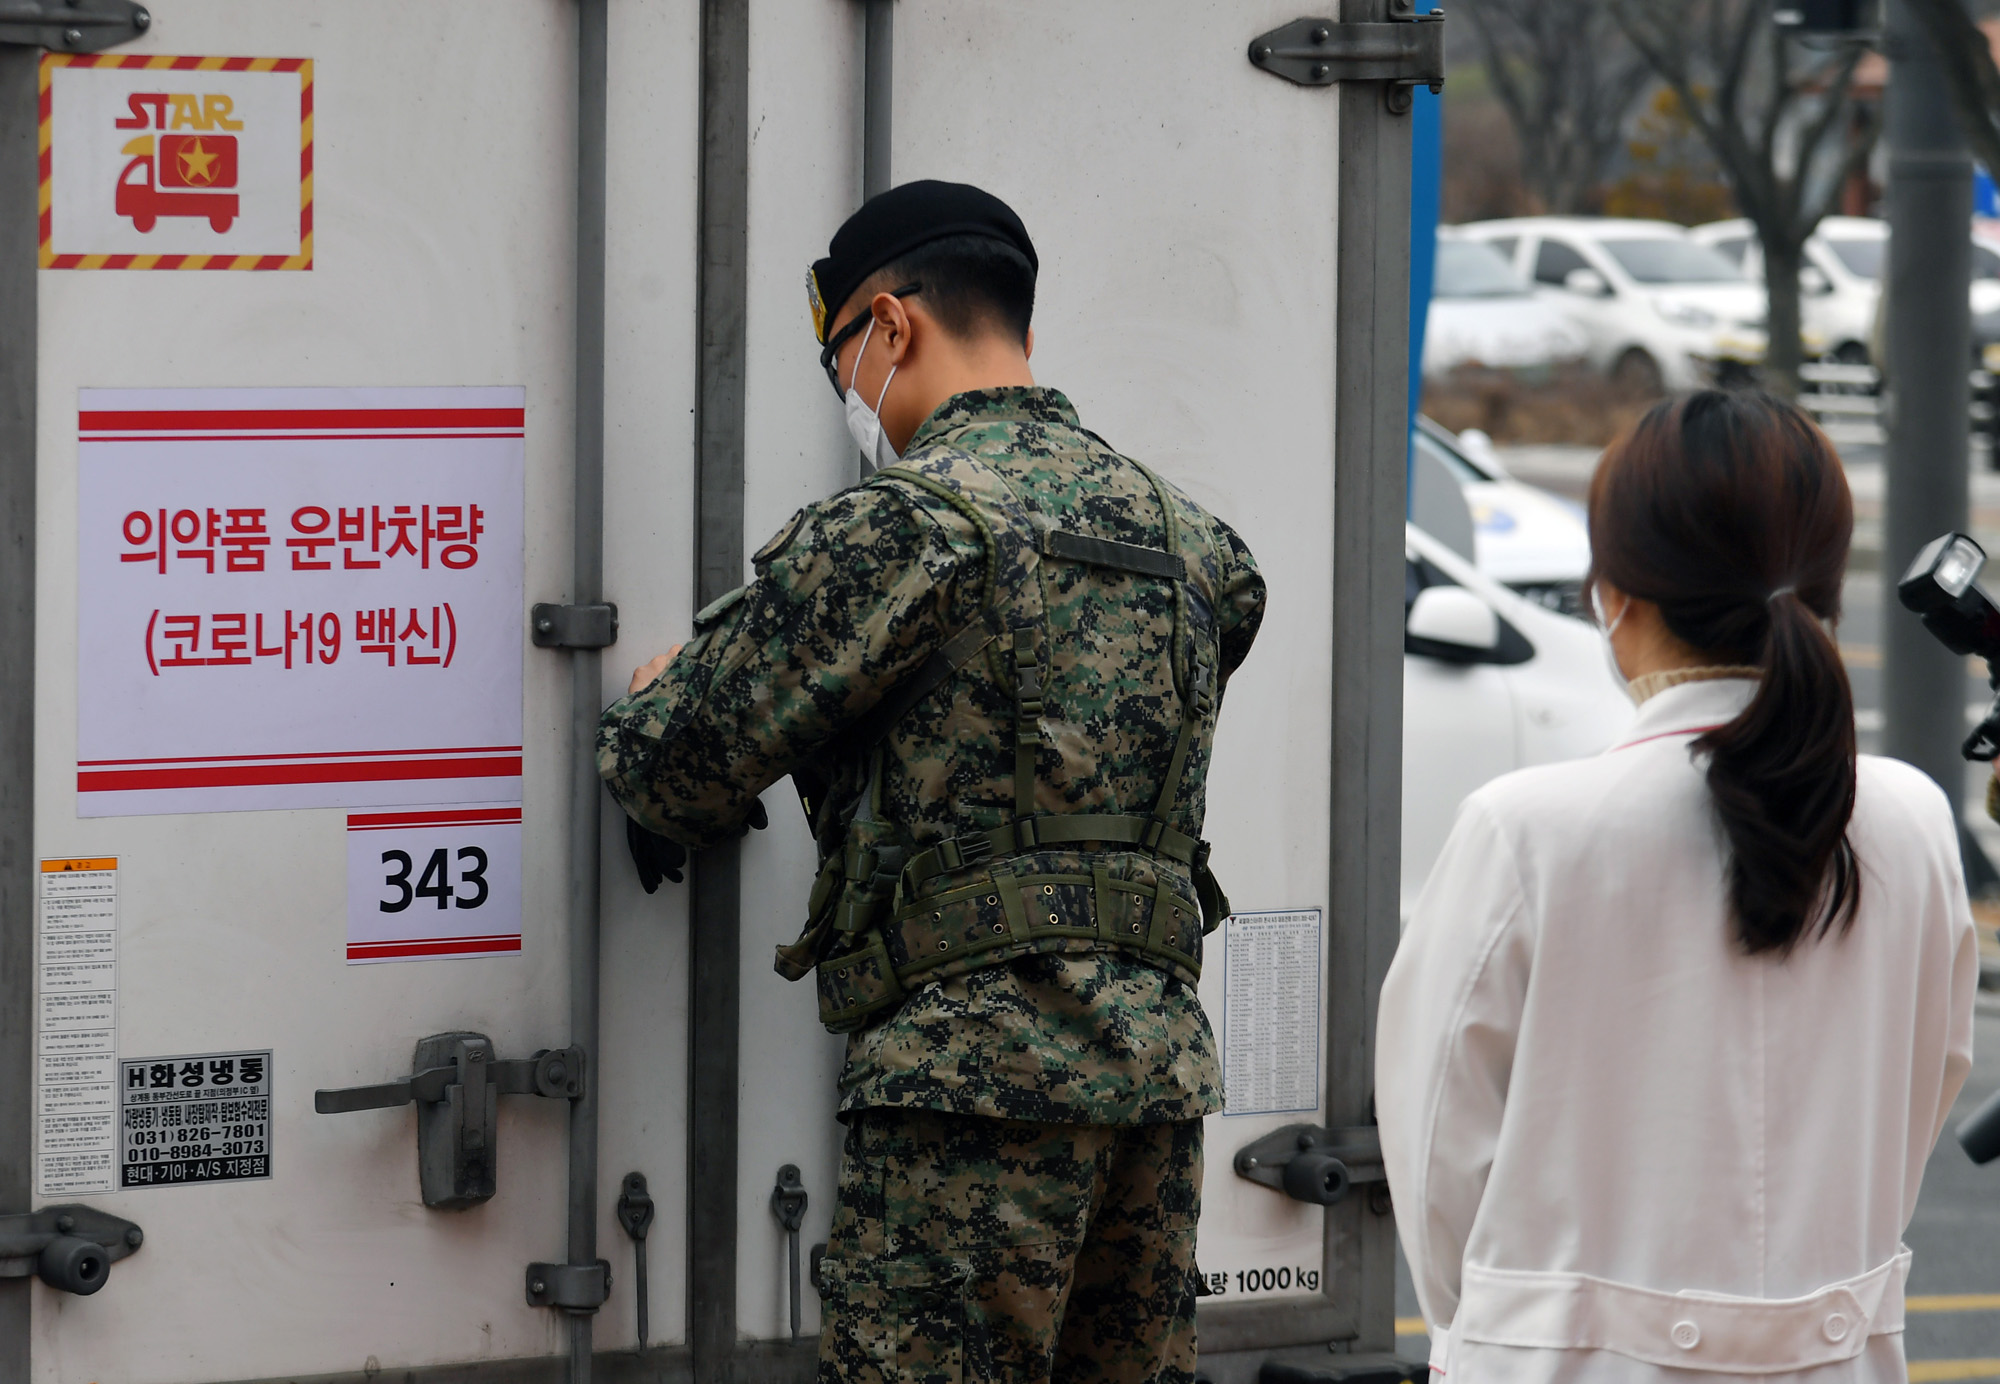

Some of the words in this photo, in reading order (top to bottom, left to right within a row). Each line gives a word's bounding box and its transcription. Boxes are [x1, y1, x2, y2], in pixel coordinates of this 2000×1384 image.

[115, 93, 244, 131] STAR
[120, 506, 271, 575] 의약품
[285, 503, 485, 572] 운반차량
[144, 609, 342, 677] (코로나19
[355, 602, 457, 669] 백신)
[379, 846, 489, 913] 343
[150, 1058, 263, 1089] 화성냉동
[128, 1140, 264, 1163] 010-8984-3073
[226, 1157, 266, 1177] 지정점
[1201, 1272, 1228, 1295] 량
[1236, 1266, 1291, 1293] 1000
[1296, 1267, 1319, 1291] kg
